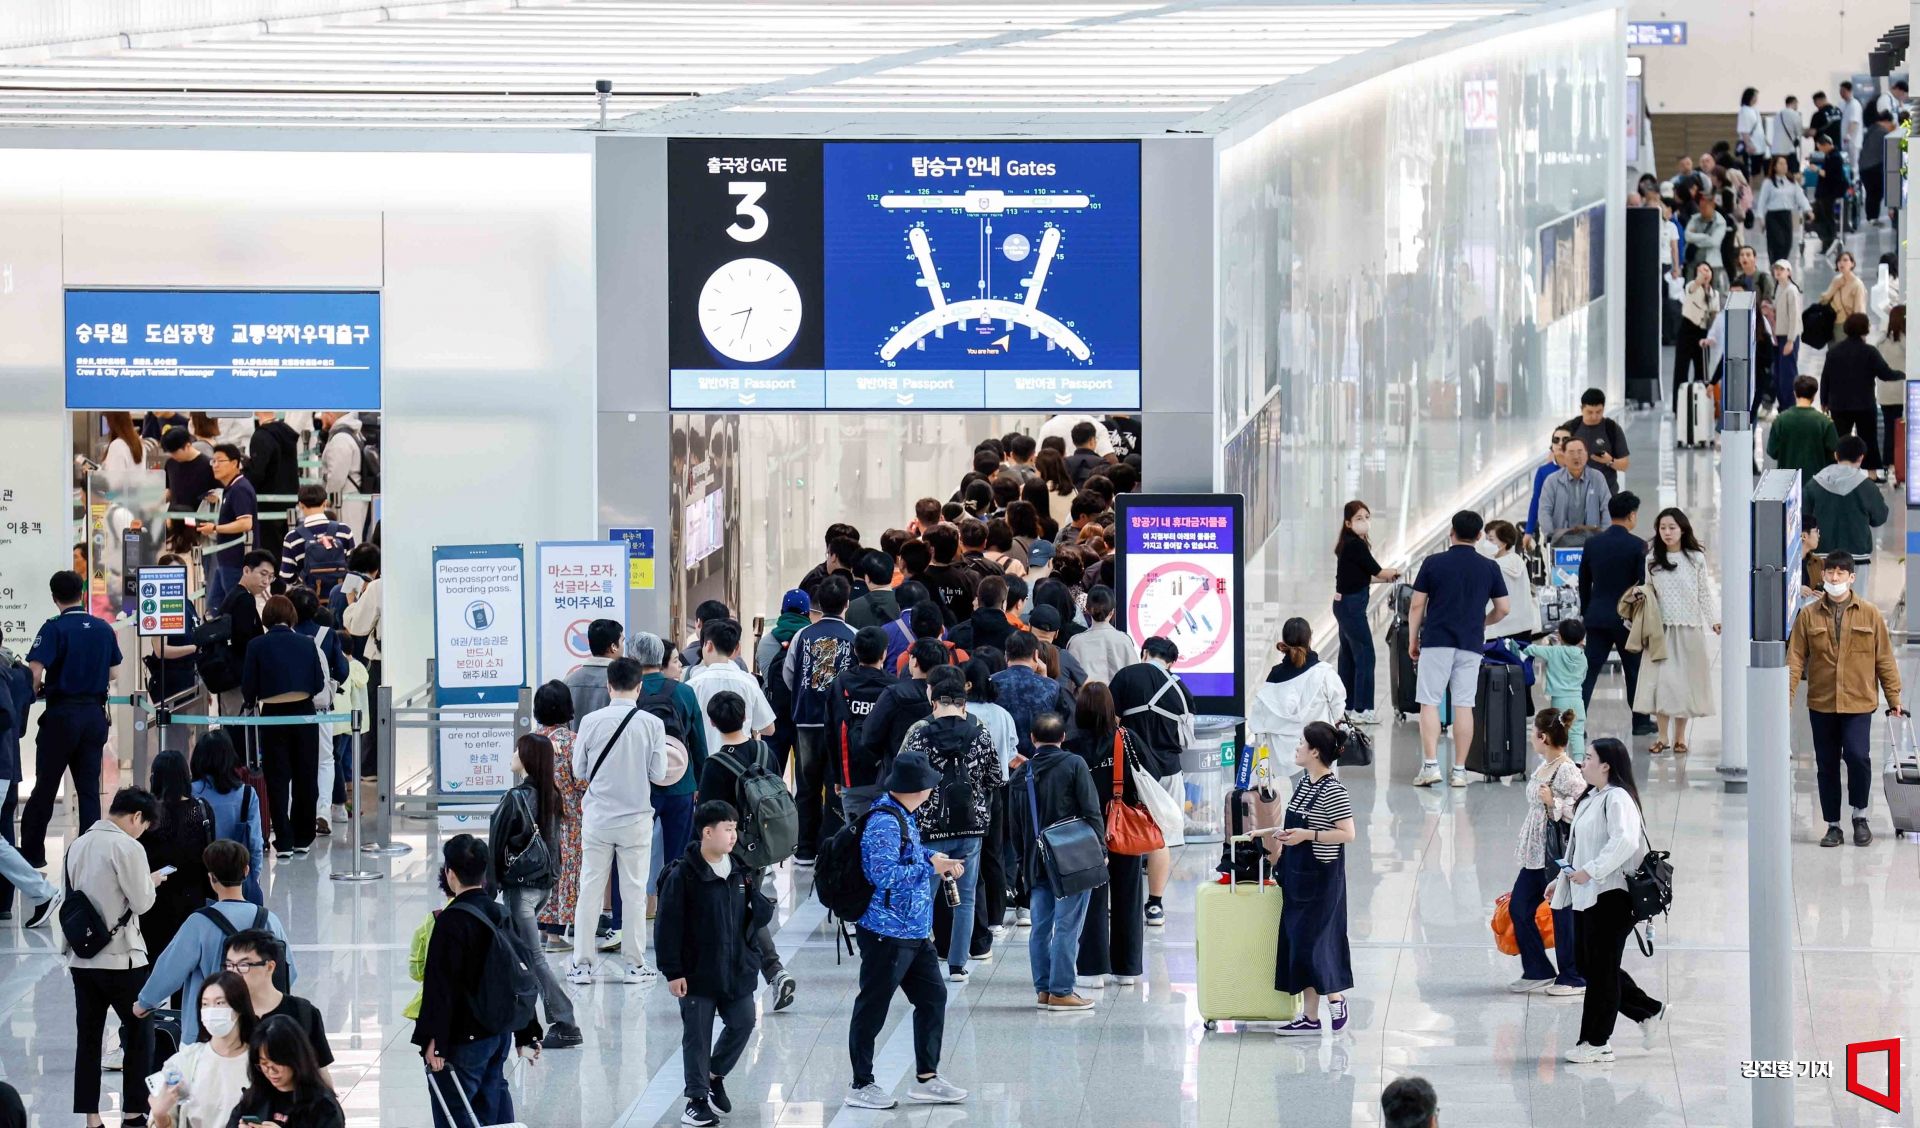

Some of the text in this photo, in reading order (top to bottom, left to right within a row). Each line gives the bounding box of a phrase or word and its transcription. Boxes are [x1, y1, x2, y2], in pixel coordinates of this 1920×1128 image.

[707, 157, 787, 174] 출국장 GATE
[911, 156, 1057, 177] 탑승구 안내 Gates
[725, 181, 769, 243] 3
[76, 323, 128, 344] 승무원
[145, 323, 215, 345] 도심공항
[120, 368, 145, 378] Airport
[232, 368, 258, 378] Priority
[744, 378, 798, 391] Passport
[902, 378, 955, 391] Passport
[1061, 378, 1113, 391] Passport
[1132, 516, 1228, 528] 항공기 내 휴대금지물품
[6, 521, 42, 535] 이용객
[439, 563, 518, 574] Please carry your
[548, 564, 588, 577] 마스크,
[590, 564, 617, 577] 모자,
[439, 574, 520, 584] own passport and
[446, 585, 512, 595] boarding pass.
[553, 580, 614, 594] 선글라스를
[554, 595, 616, 610] 벗어주세요
[0, 620, 26, 633] 승객
[4, 635, 32, 643] assengers
[450, 636, 508, 647] 여권/탑승권은
[466, 648, 493, 658] 반드시
[456, 658, 504, 669] 본인이 소지
[462, 669, 498, 679] 해주세요
[448, 732, 464, 740] are
[465, 731, 480, 739] not
[464, 740, 502, 749] to enter.
[470, 754, 499, 764] 환송객
[473, 765, 493, 775] 절대
[1240, 752, 1250, 784] ARTBOX
[465, 775, 504, 786] 진입금지
[930, 832, 949, 840] RYAN
